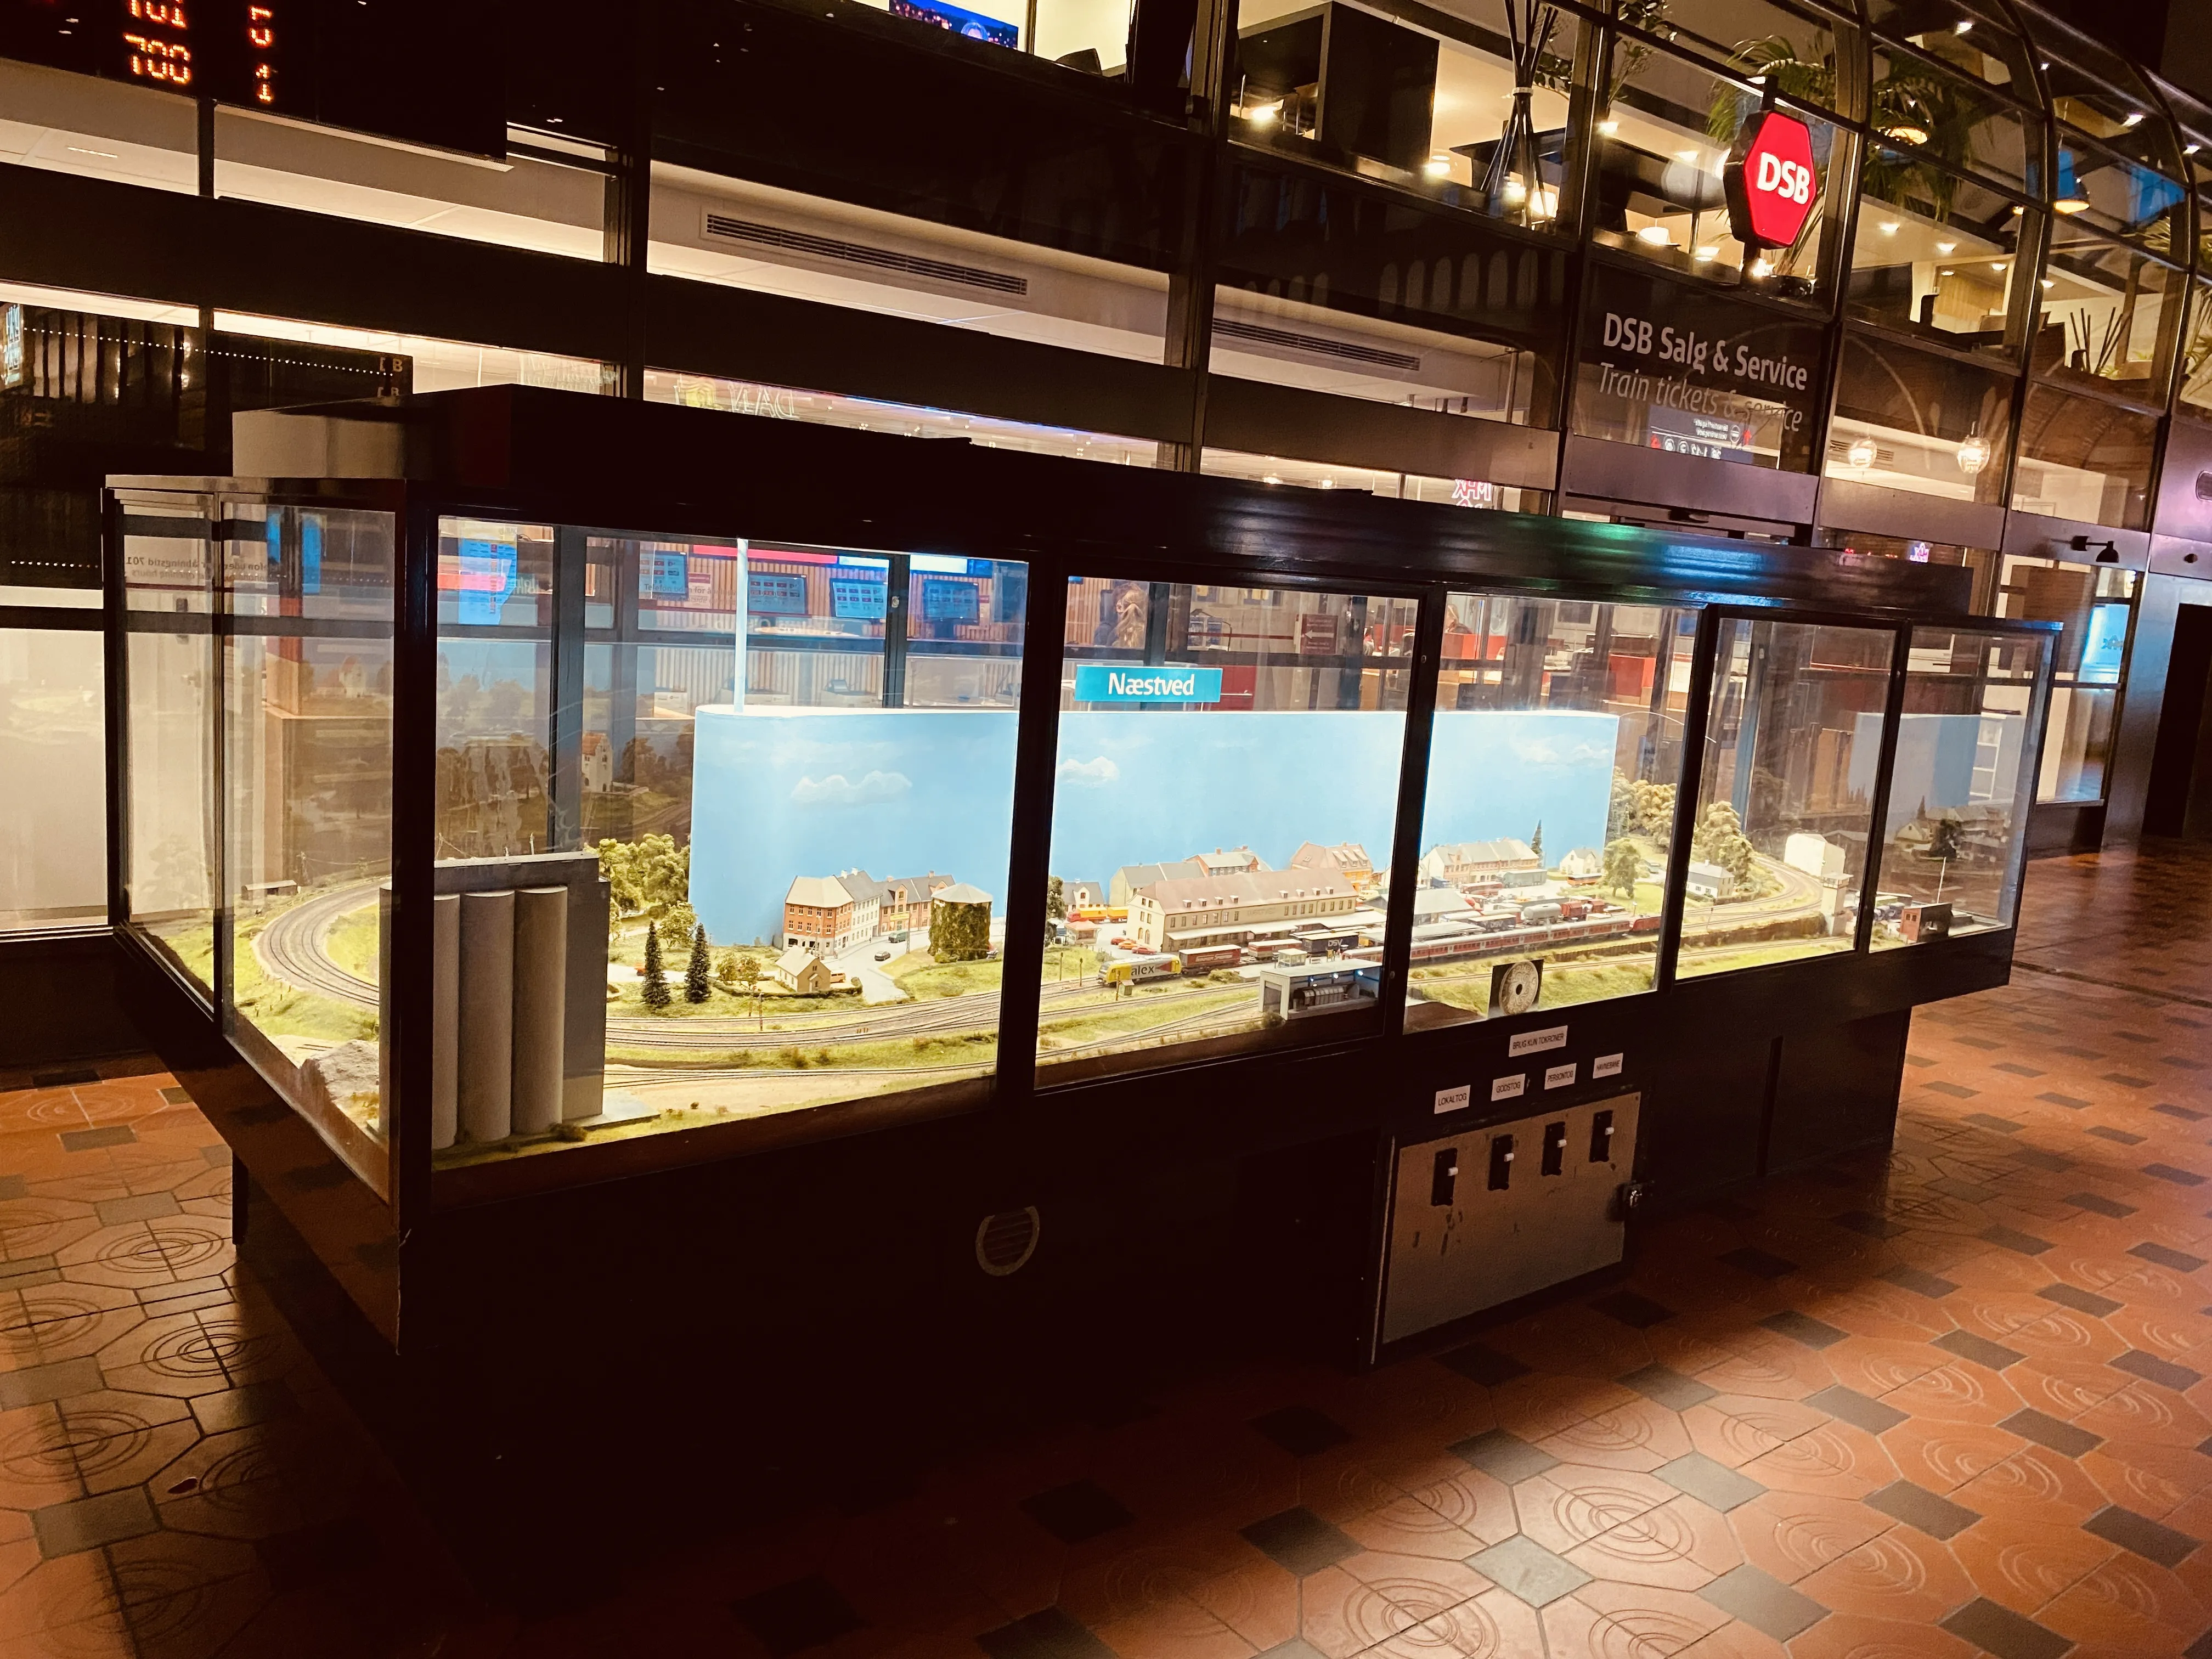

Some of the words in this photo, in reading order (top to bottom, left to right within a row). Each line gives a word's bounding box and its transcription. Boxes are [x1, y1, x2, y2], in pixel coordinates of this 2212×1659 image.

[125, 35, 189, 83] 700
[1757, 151, 1811, 205] DSB
[1603, 312, 1654, 355] DSB
[1659, 326, 1708, 375] Salg
[1712, 339, 1729, 373] &
[1734, 345, 1808, 391] Service
[1599, 361, 1650, 402] Train
[1655, 374, 1718, 415] tickets
[1723, 388, 1740, 418] &
[1744, 399, 1803, 432] service
[644, 583, 672, 592] Telefon
[1108, 672, 1195, 696] Næstved
[1491, 920, 1504, 928] DSV
[1328, 939, 1342, 947] DSV
[1131, 964, 1154, 976] alex
[1513, 1040, 1527, 1049] BRUG
[1547, 1070, 1574, 1082] PERSONTOG
[1496, 1081, 1521, 1094] GODSTOG
[1437, 1092, 1467, 1107] LOKALTOG
